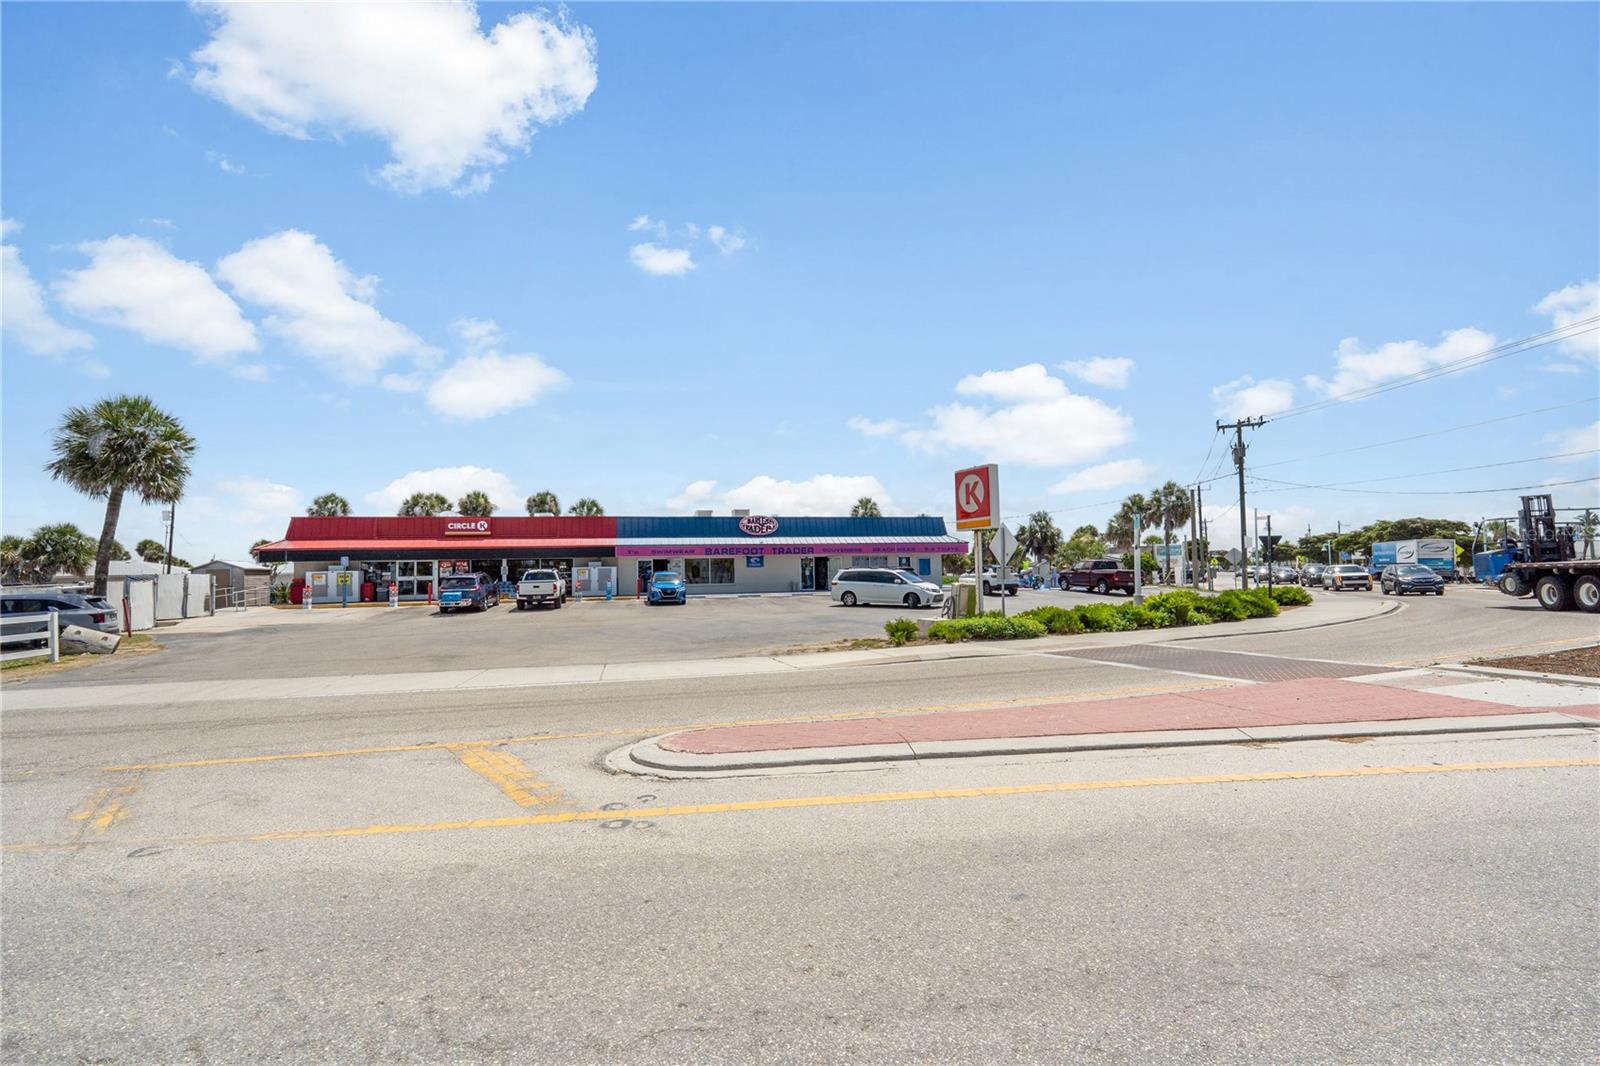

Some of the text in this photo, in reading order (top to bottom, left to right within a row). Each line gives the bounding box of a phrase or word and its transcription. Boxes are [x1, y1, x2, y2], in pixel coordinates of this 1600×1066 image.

[962, 478, 983, 509] K
[447, 522, 476, 530] CIRCLE
[704, 547, 764, 556] BAREFOOT
[772, 546, 815, 555] TRADER
